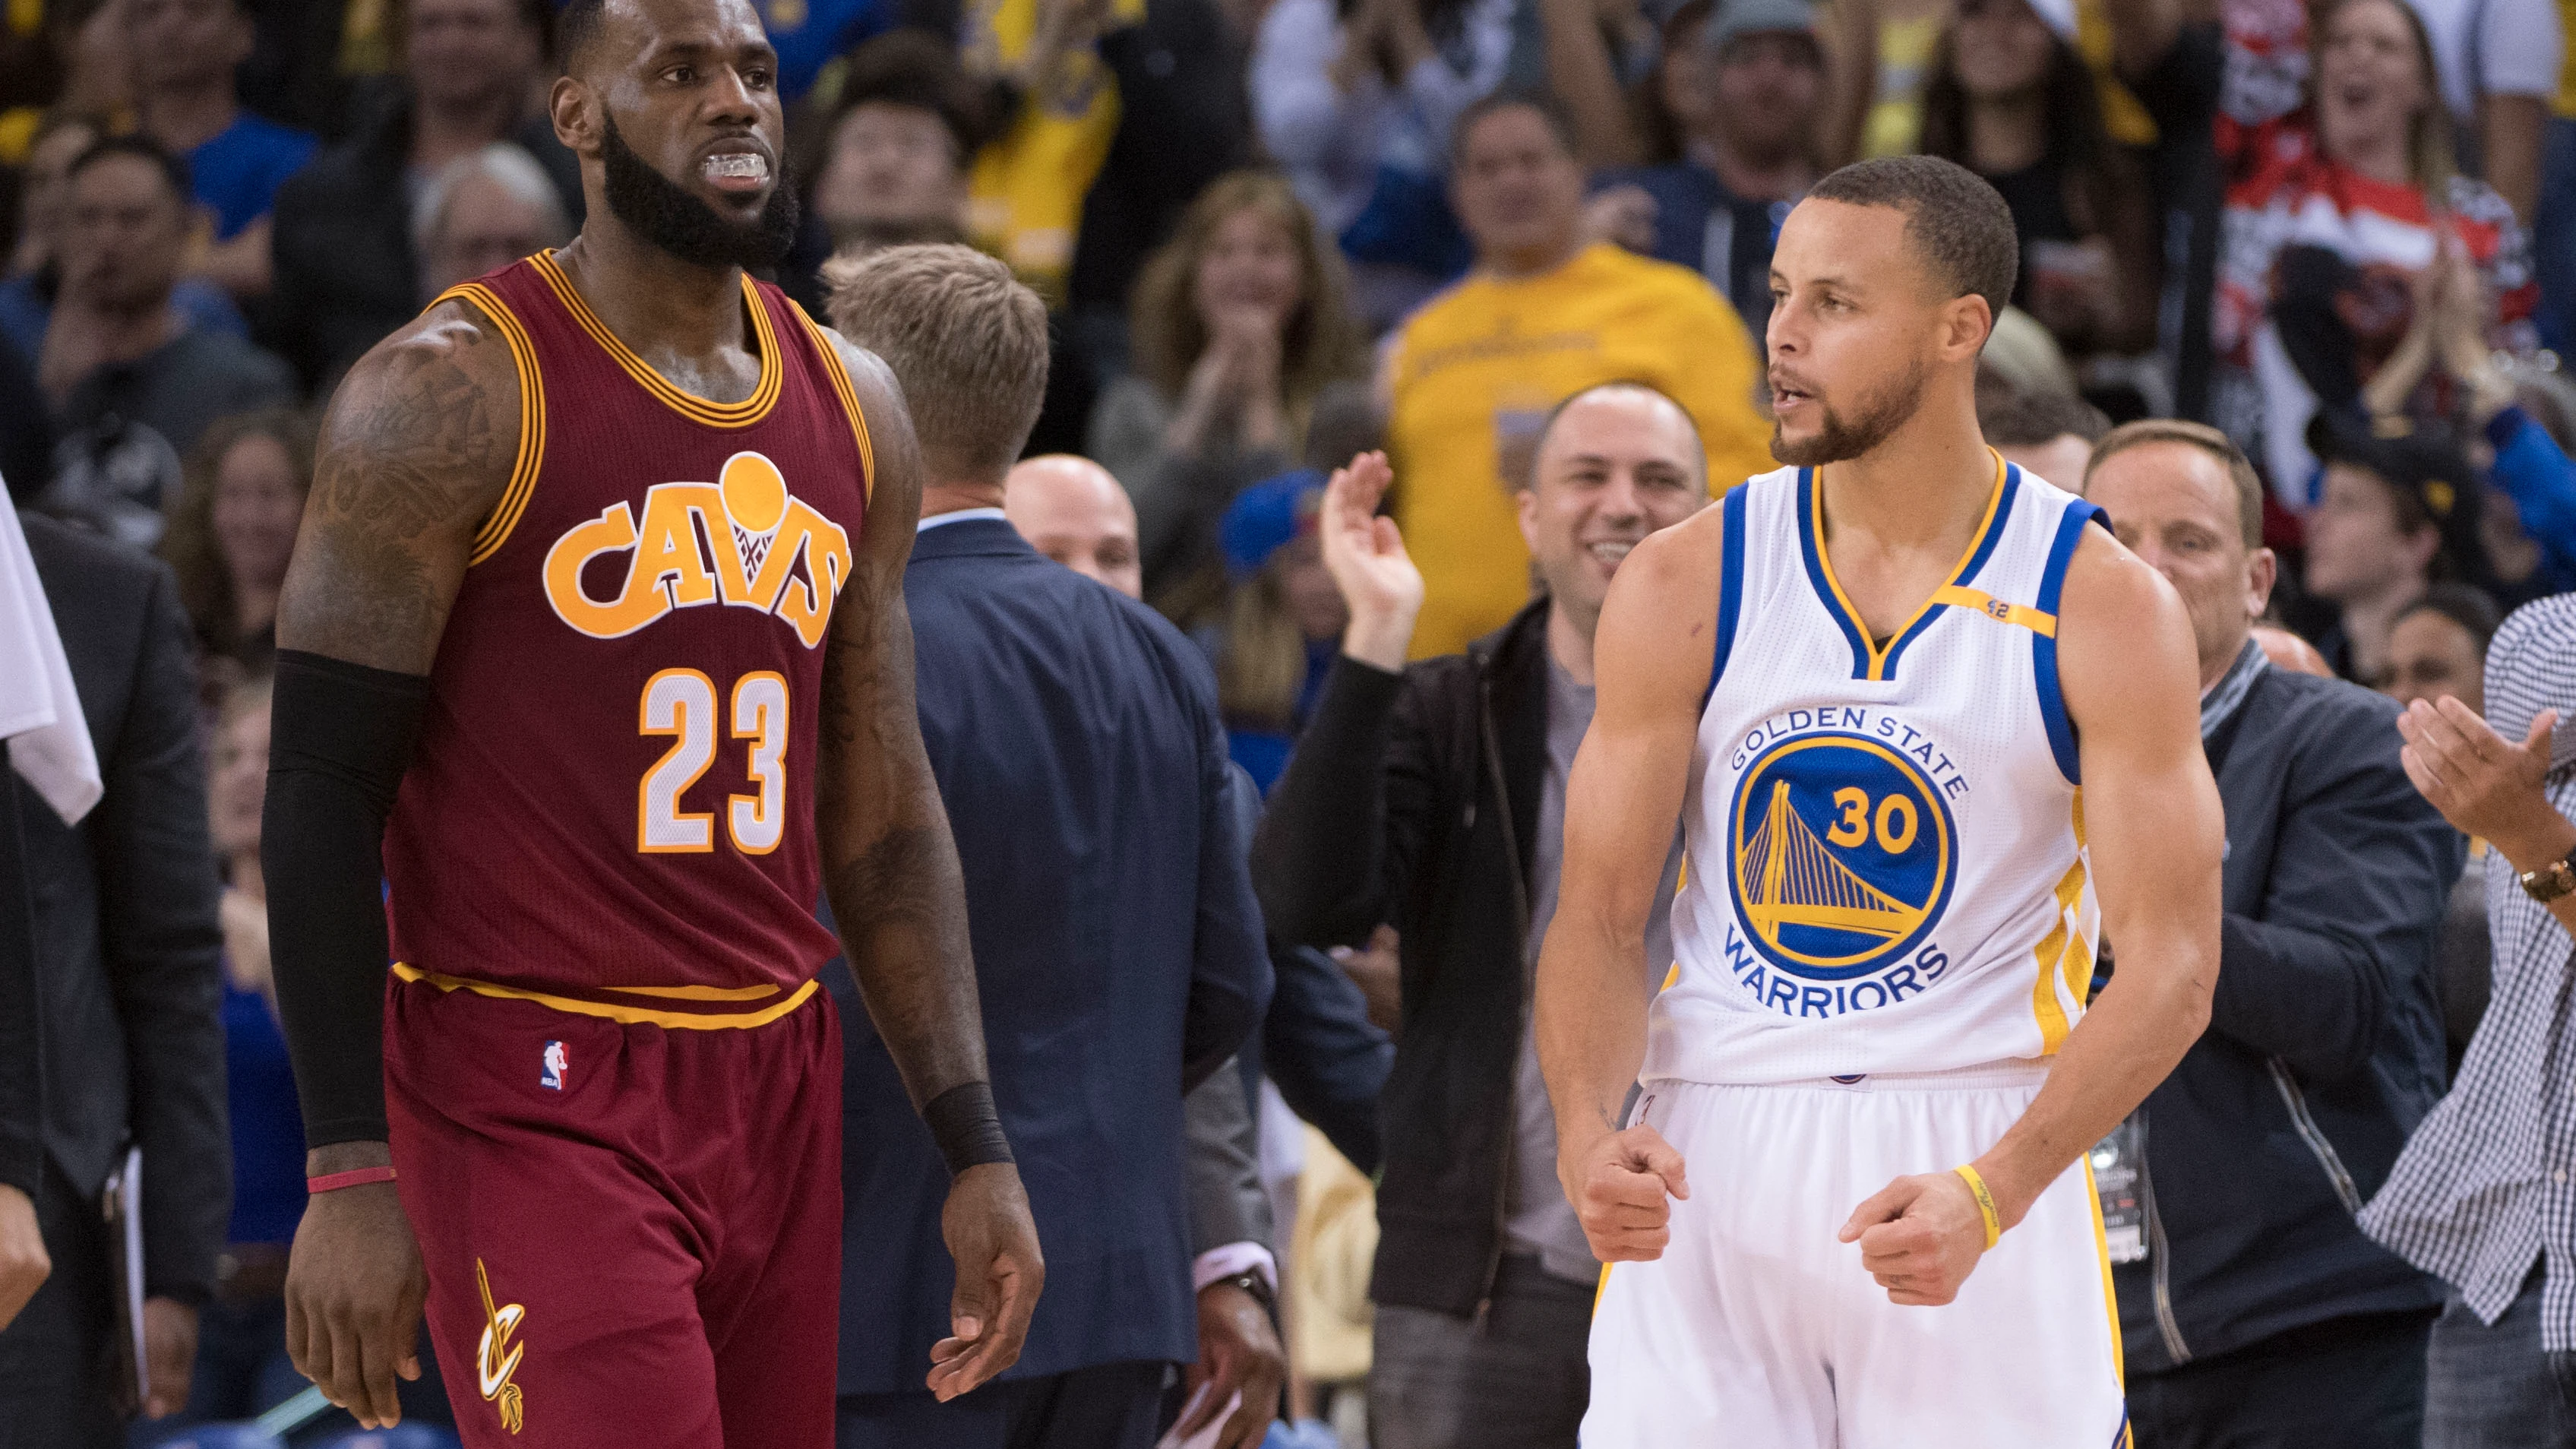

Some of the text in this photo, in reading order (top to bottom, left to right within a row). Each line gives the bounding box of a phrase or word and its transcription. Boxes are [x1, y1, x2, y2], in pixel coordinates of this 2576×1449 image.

[542, 451, 852, 650] CAVS
[638, 667, 790, 856] 23
[1731, 707, 1970, 800] GOLDEN STATE
[1826, 786, 1919, 855] 30
[1724, 922, 1949, 1020] WARRIORS
[541, 1077, 558, 1087] NBA
